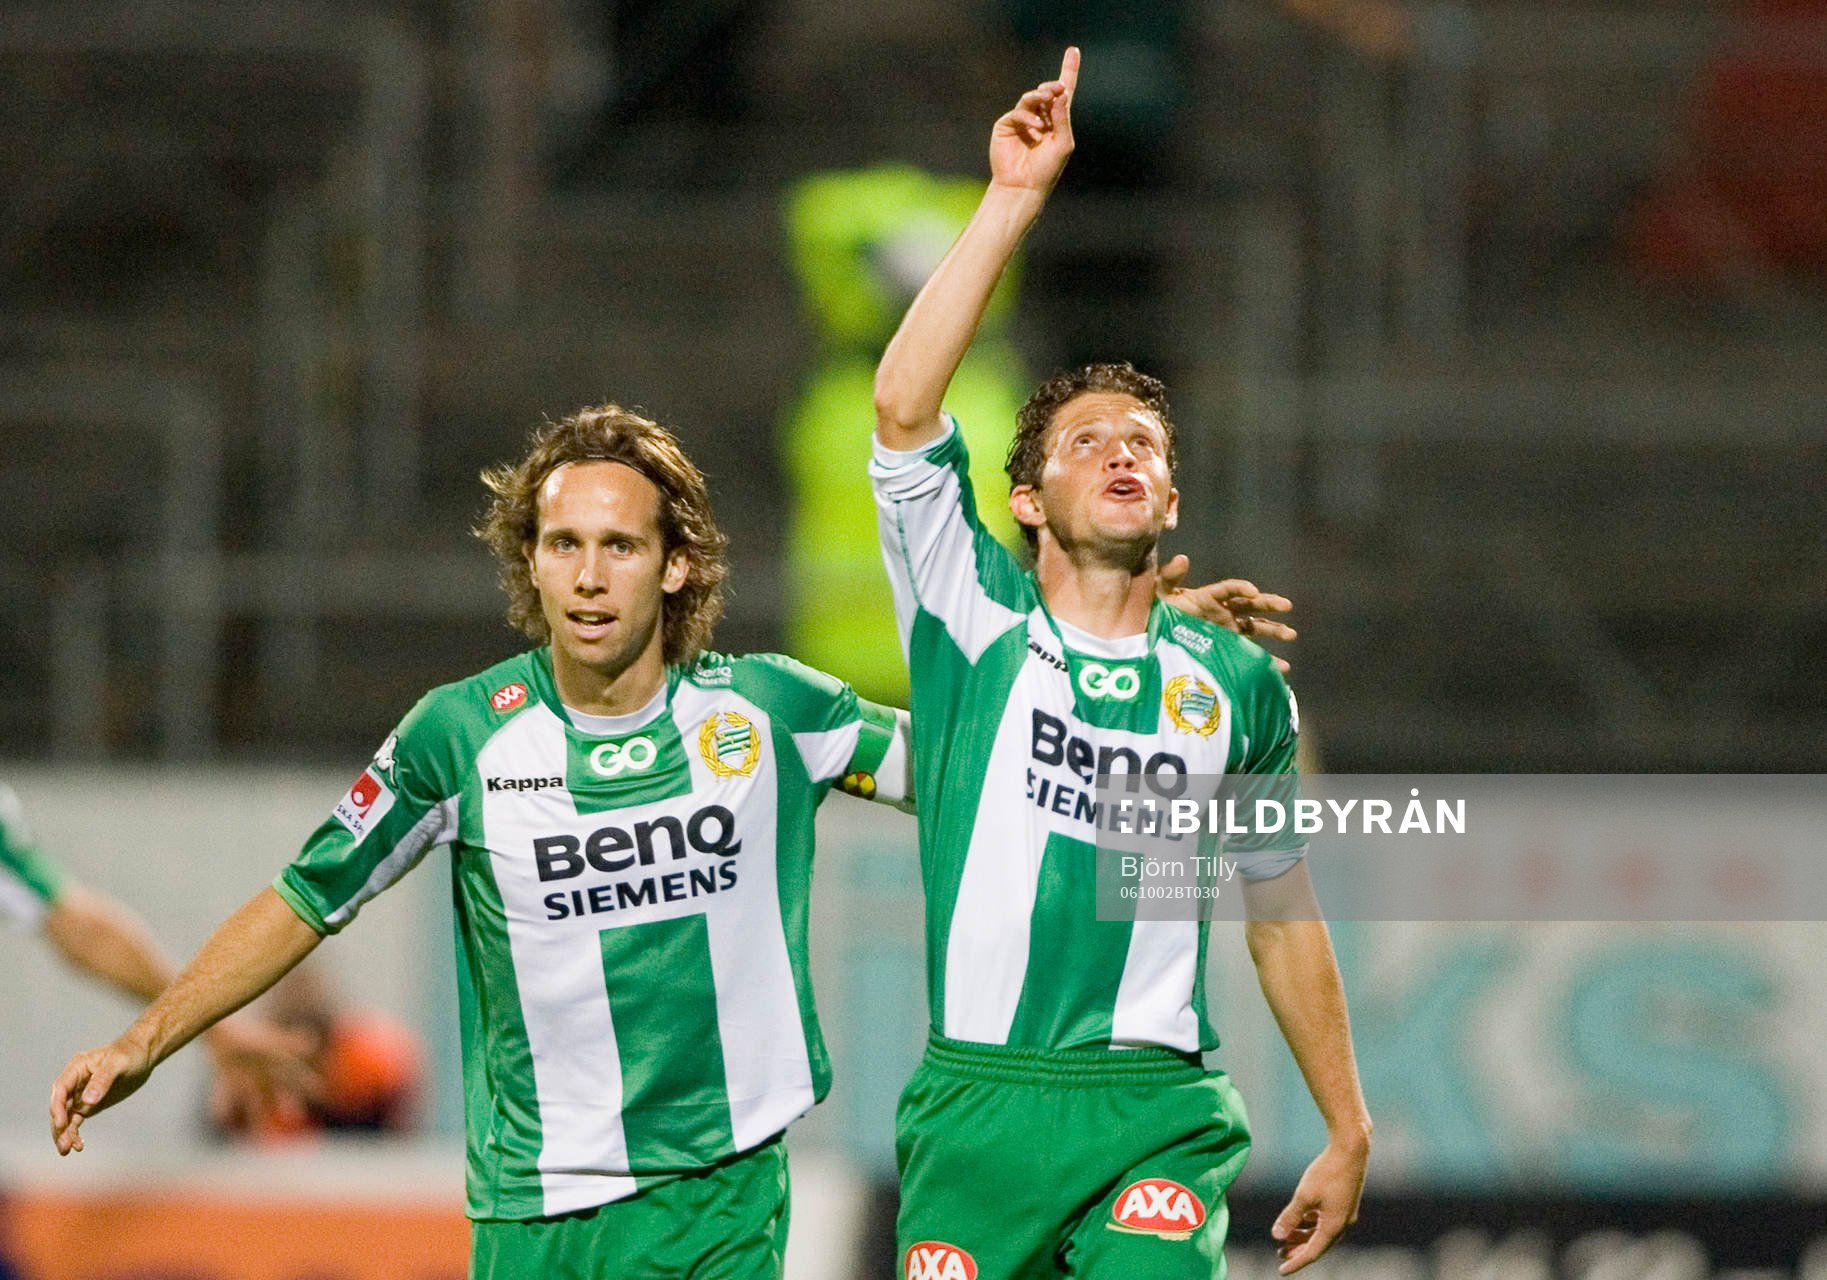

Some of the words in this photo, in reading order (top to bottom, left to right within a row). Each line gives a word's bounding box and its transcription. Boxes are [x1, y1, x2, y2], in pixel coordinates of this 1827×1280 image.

[1028, 639, 1069, 673] app
[493, 684, 526, 709] AXA
[1078, 663, 1141, 699] GO
[590, 736, 657, 776] GO
[487, 776, 563, 792] Kappa
[533, 804, 742, 882] BenQ
[544, 861, 738, 920] SIEMENS
[1119, 1184, 1198, 1225] AXA
[907, 1248, 967, 1280] AXA
